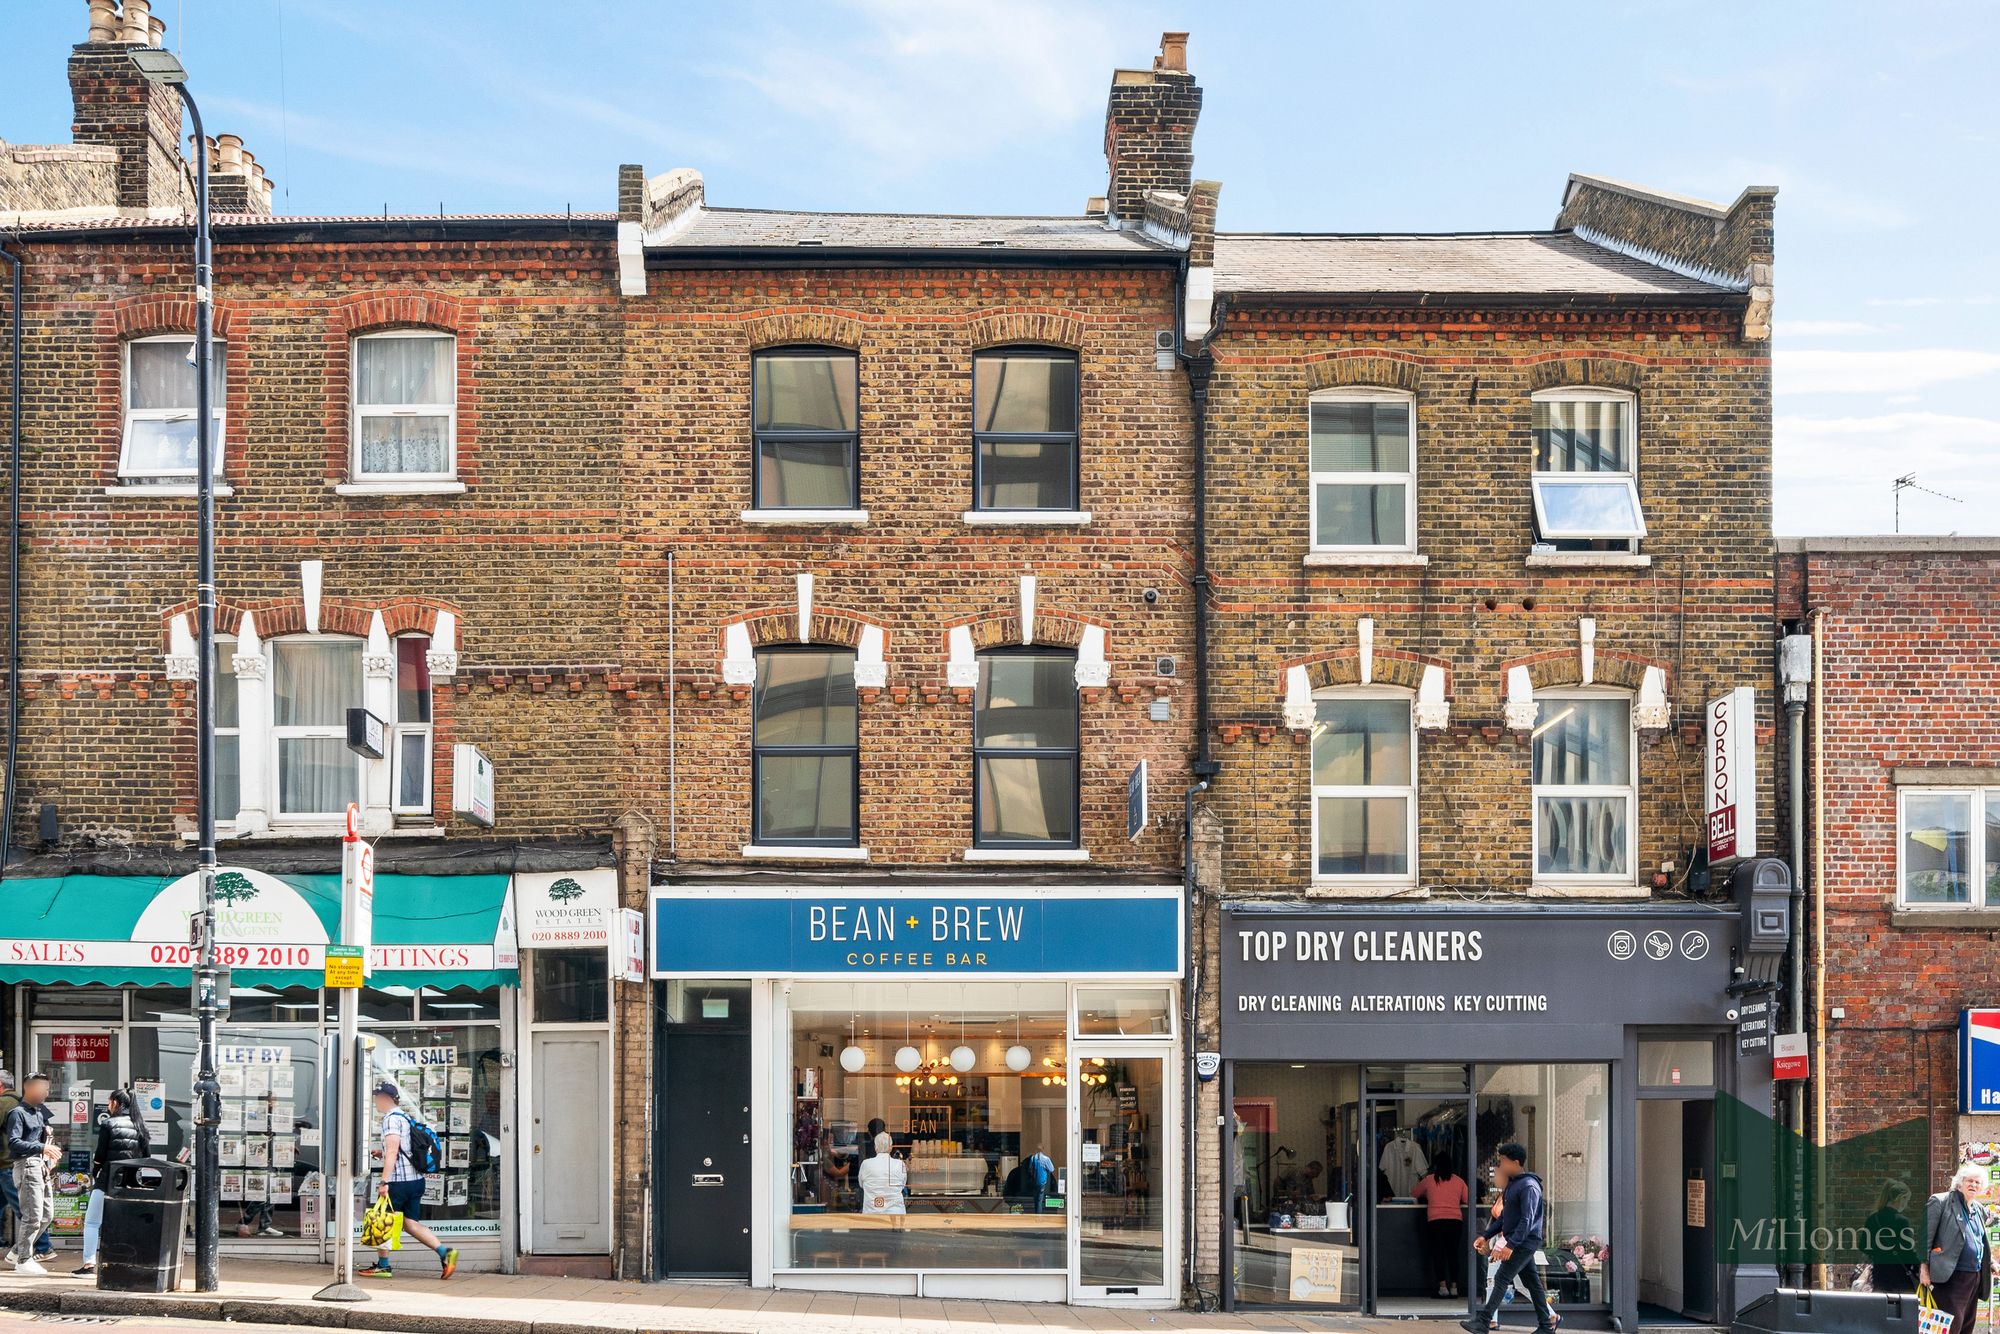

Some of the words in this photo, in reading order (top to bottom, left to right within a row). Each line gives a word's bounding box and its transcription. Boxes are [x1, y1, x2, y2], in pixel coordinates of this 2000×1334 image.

[1713, 701, 1728, 809] CORDON
[1711, 810, 1734, 840] BELL
[535, 909, 567, 918] WOOD
[568, 907, 601, 917] GREEN
[535, 917, 603, 925] ESTATES
[810, 906, 894, 941] BEAN
[932, 906, 1024, 941] BREW
[531, 931, 552, 941] 020
[554, 931, 580, 940] 8889
[583, 930, 607, 940] 2010
[11, 942, 85, 962] SALES
[1239, 931, 1287, 961] TOP
[1296, 931, 1344, 961] DRY
[1353, 931, 1483, 961] CLEANERS
[150, 945, 190, 963] 020
[257, 947, 309, 965] 2010
[847, 953, 933, 965] COFFEE
[946, 953, 988, 965] BAR
[1238, 995, 1267, 1012] DRY
[1271, 995, 1342, 1012] CLEANING
[1351, 995, 1446, 1012] ALTERATIONS
[1454, 995, 1480, 1012] KEY
[1486, 995, 1548, 1012] CUTTING
[1741, 1006, 1749, 1015] DRY
[1748, 1003, 1767, 1014] CLEANING
[1741, 1020, 1767, 1031] ALTERATIONS
[53, 1038, 80, 1047] HOUSES
[82, 1039, 88, 1047] &
[90, 1039, 109, 1047] FLATS
[1741, 1039, 1749, 1048] KEY
[1750, 1037, 1767, 1047] CUTTING
[66, 1051, 96, 1059] WANTED
[225, 1048, 255, 1063] LET
[261, 1048, 284, 1063] BY
[420, 1049, 454, 1065] SALE
[903, 1120, 937, 1133] BEAN
